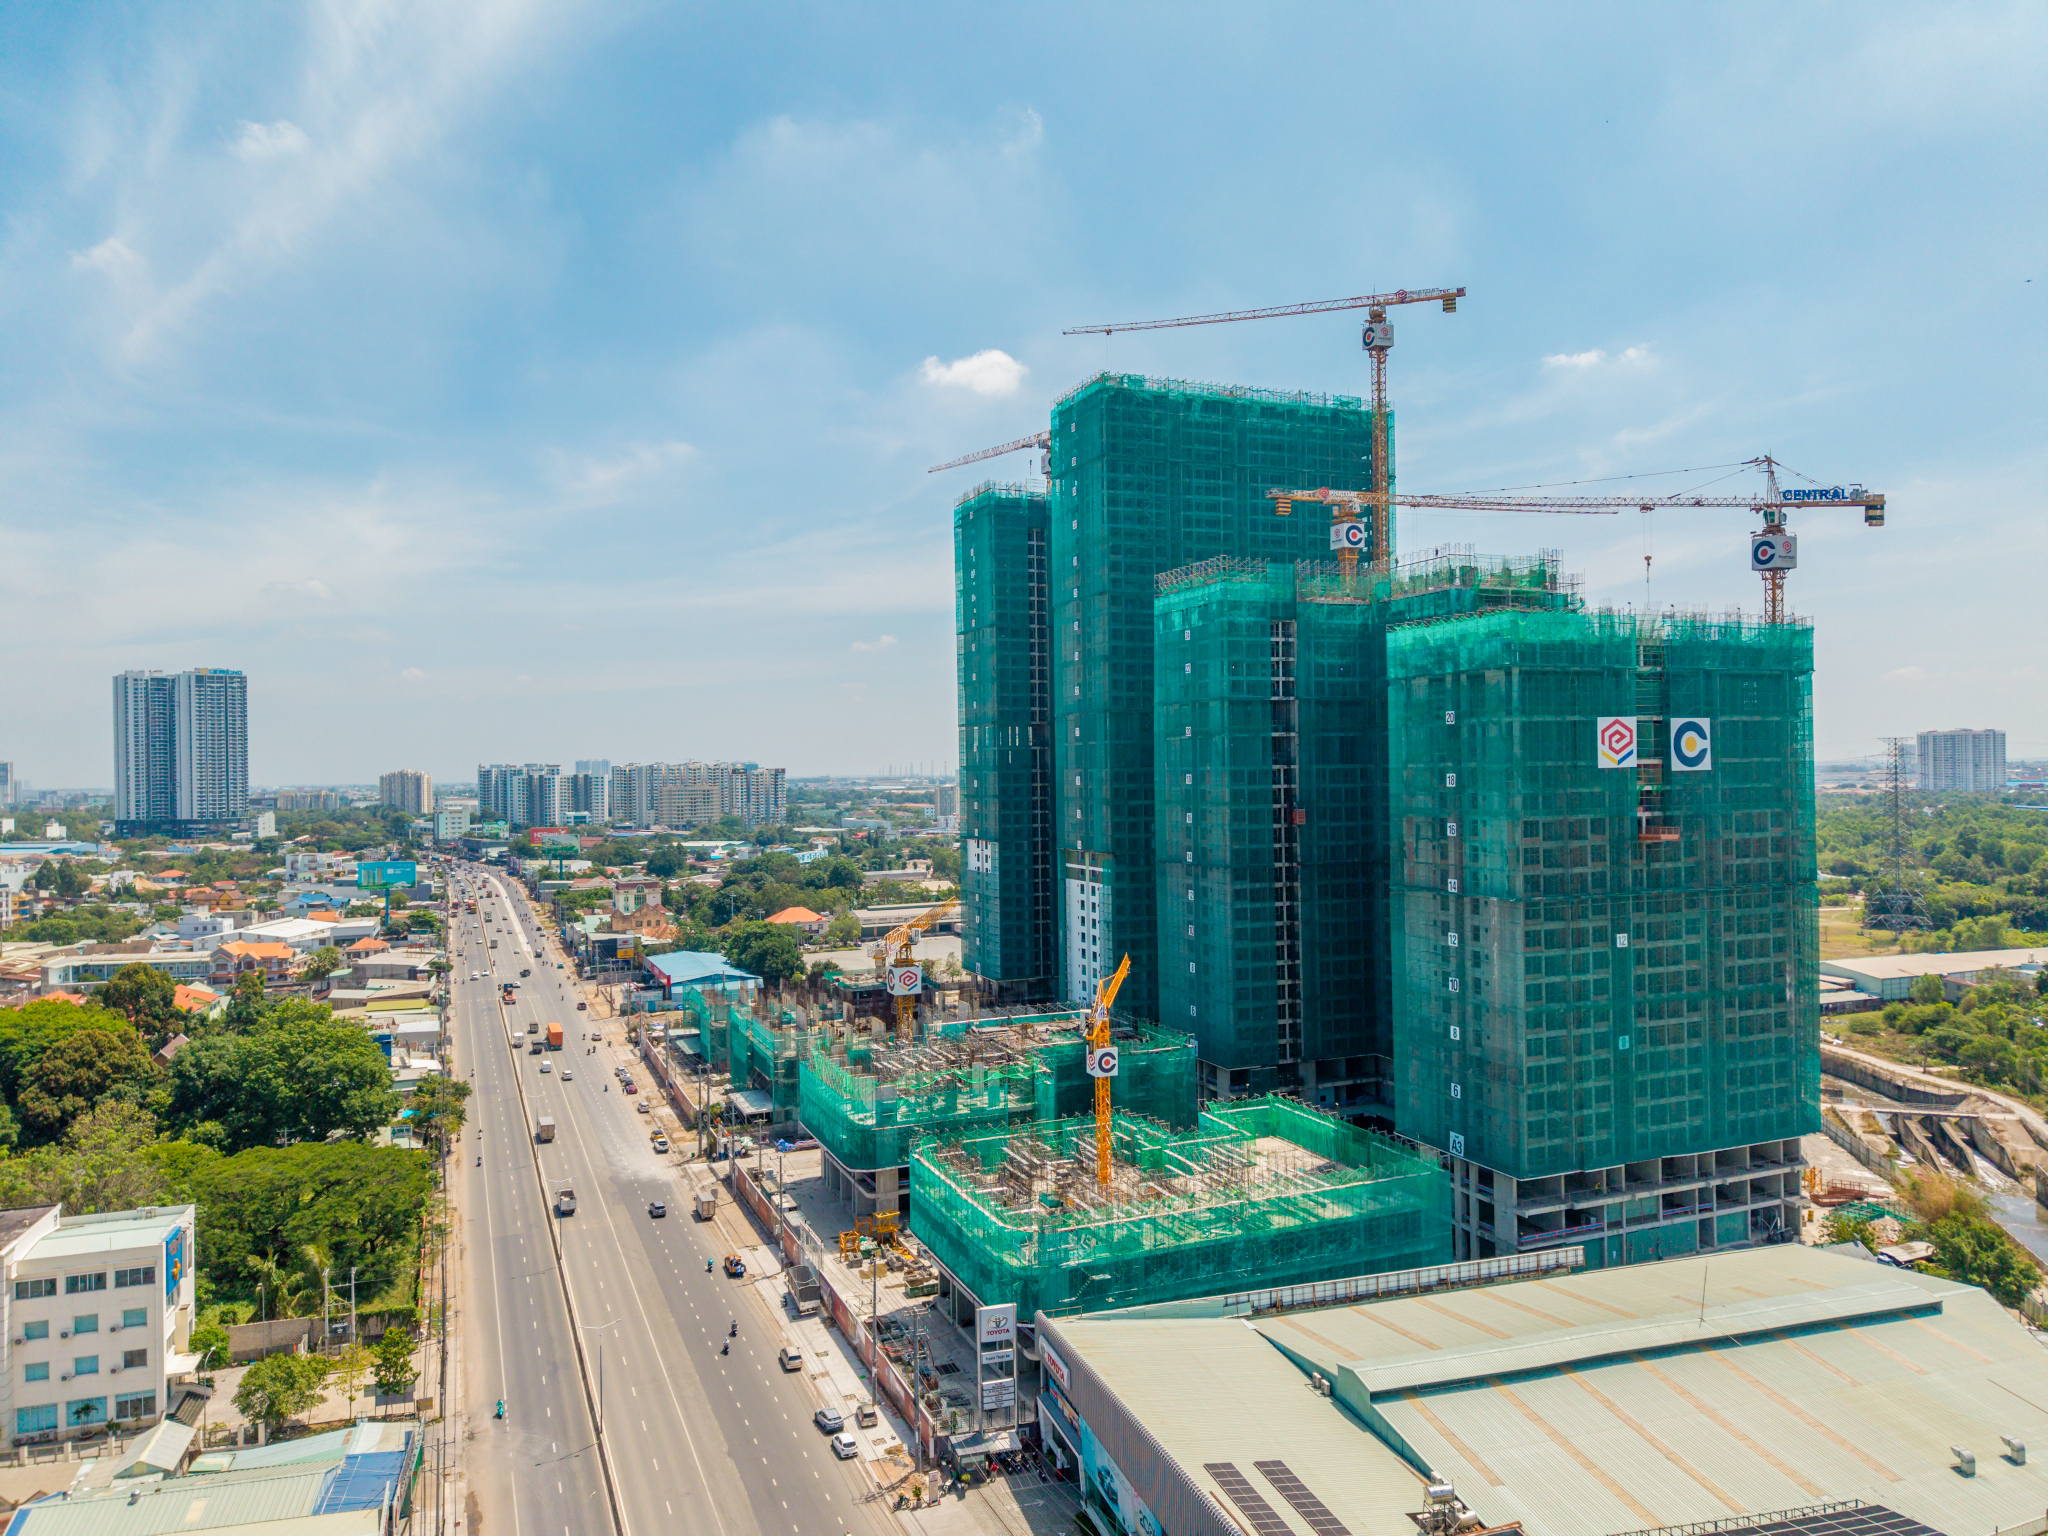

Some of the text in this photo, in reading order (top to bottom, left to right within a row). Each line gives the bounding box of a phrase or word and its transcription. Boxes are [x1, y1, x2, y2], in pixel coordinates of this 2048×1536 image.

[1782, 488, 1849, 501] CENTRAL
[1446, 712, 1455, 723] 20
[1447, 775, 1455, 786] 18
[1447, 824, 1456, 835] 16
[1448, 880, 1457, 891] 14
[1449, 934, 1457, 945] 12
[1617, 935, 1626, 946] 12
[1449, 978, 1458, 992] 10
[1452, 1027, 1457, 1039] 8
[1453, 1084, 1459, 1096] 6
[1451, 1138, 1463, 1155] A3
[986, 1328, 1010, 1337] TOYOTA
[1047, 1351, 1065, 1383] TOYOTA
